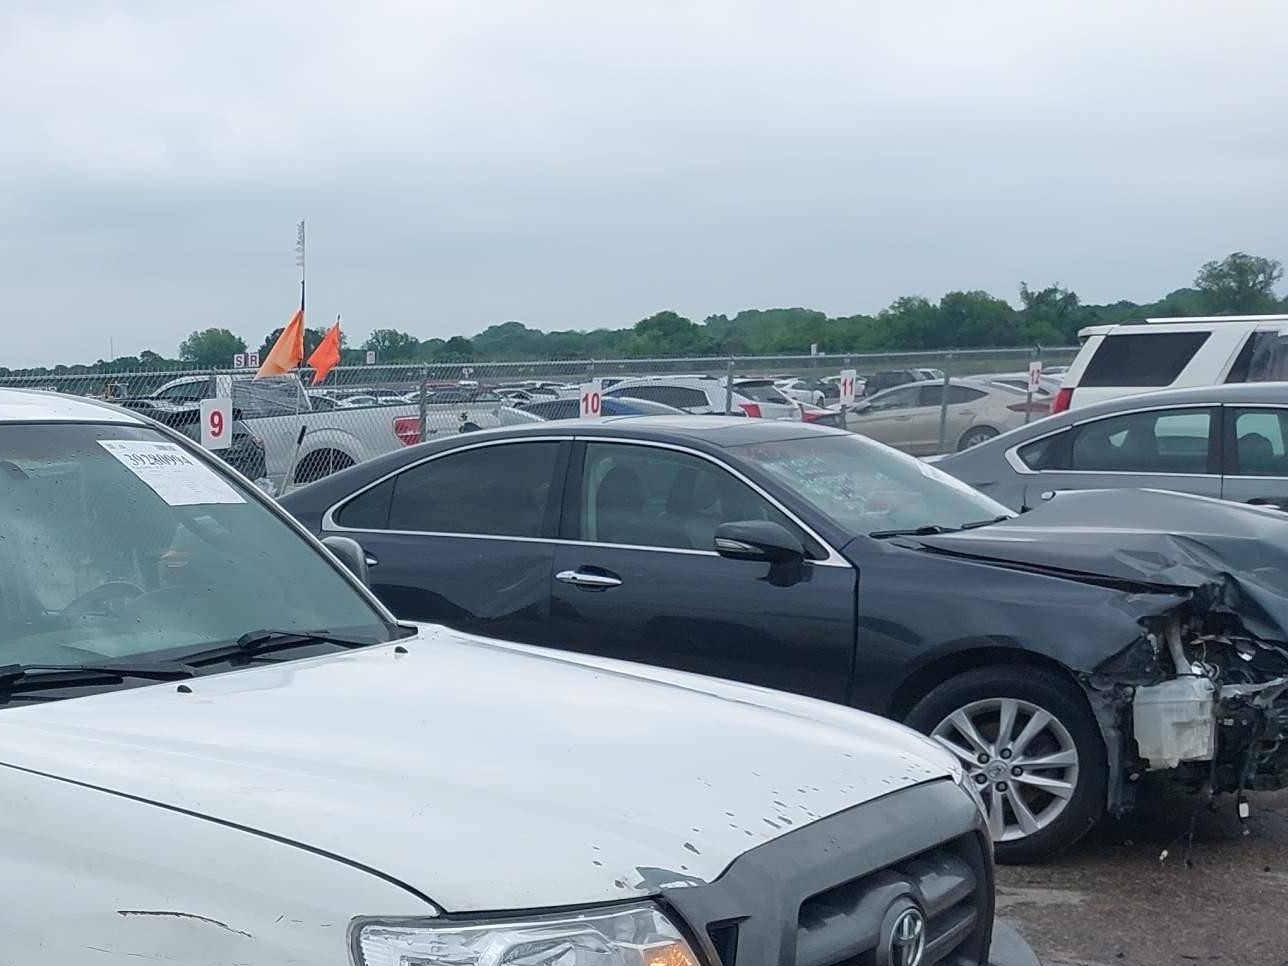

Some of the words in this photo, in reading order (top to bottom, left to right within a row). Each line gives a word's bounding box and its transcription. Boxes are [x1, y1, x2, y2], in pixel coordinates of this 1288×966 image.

[1030, 369, 1040, 384] 12
[843, 378, 854, 396] 11
[583, 392, 600, 415] 10
[210, 410, 223, 437] 9
